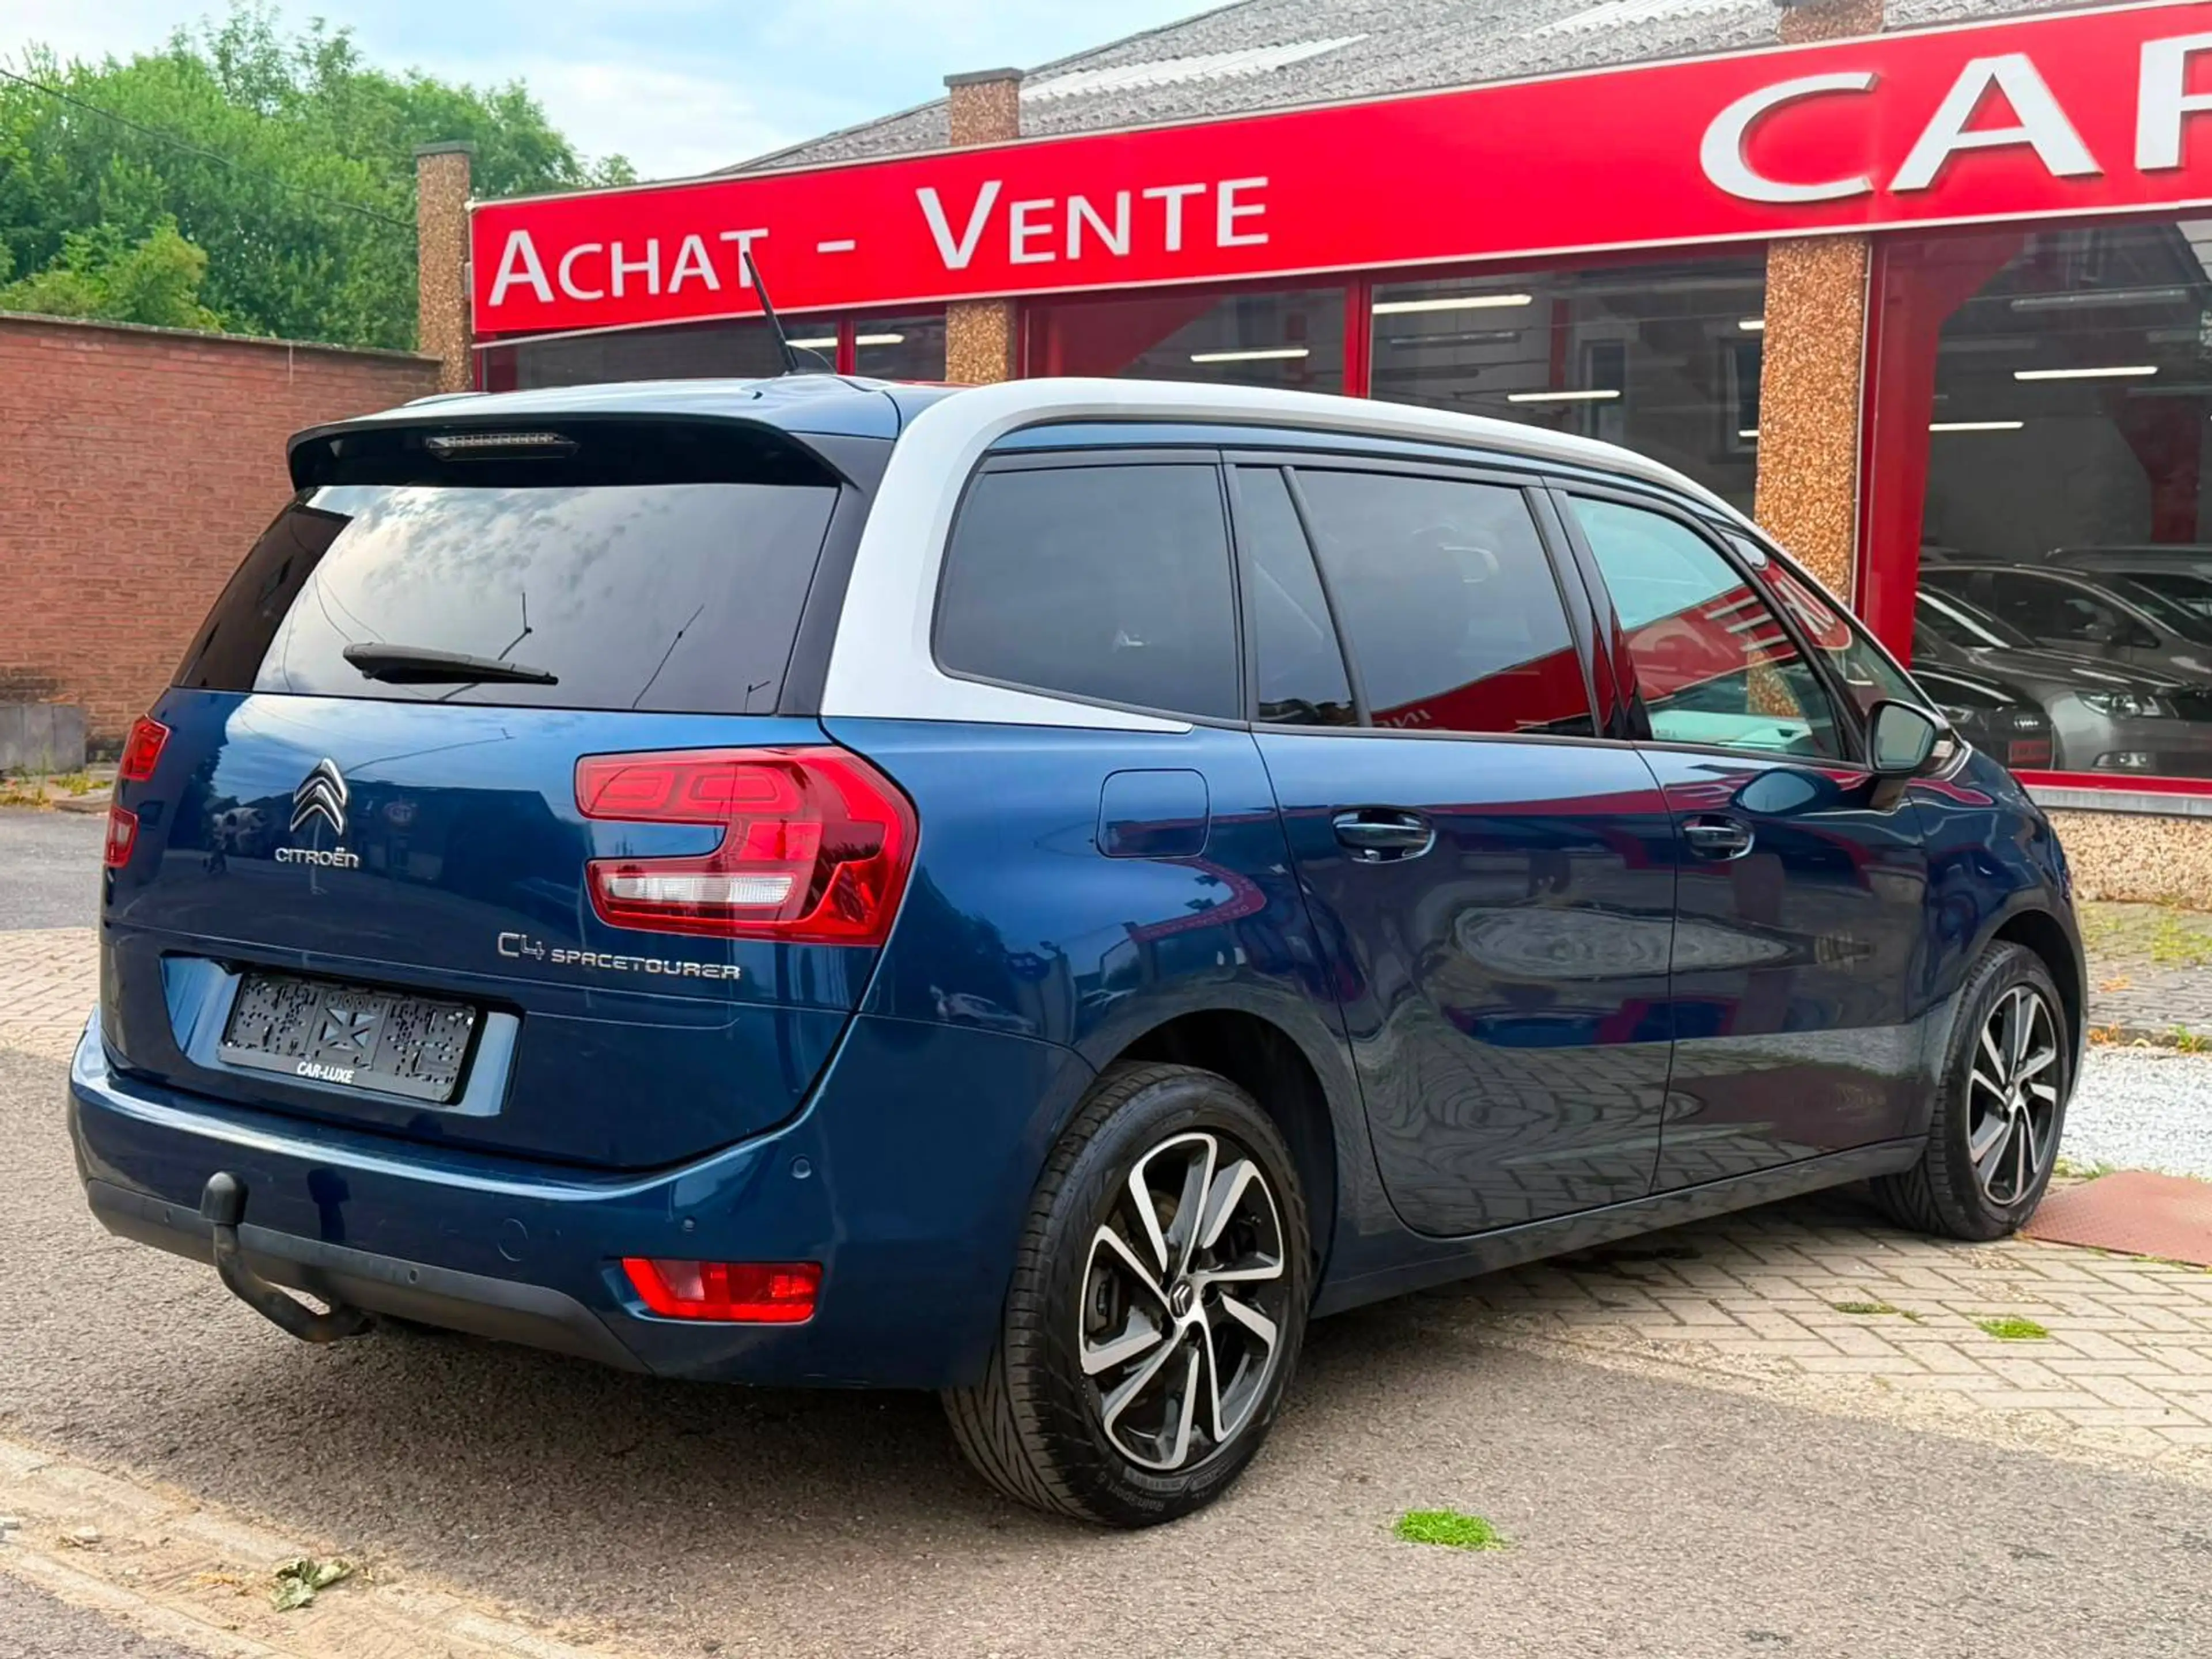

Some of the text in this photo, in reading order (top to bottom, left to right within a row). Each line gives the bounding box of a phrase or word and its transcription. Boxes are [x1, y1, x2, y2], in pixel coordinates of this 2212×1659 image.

[488, 176, 1270, 307] ACHAT - VENTE
[275, 846, 360, 869] CITROËN
[497, 931, 741, 980] C4 SPACETOURER
[297, 1061, 355, 1084] CAR-LUXE
